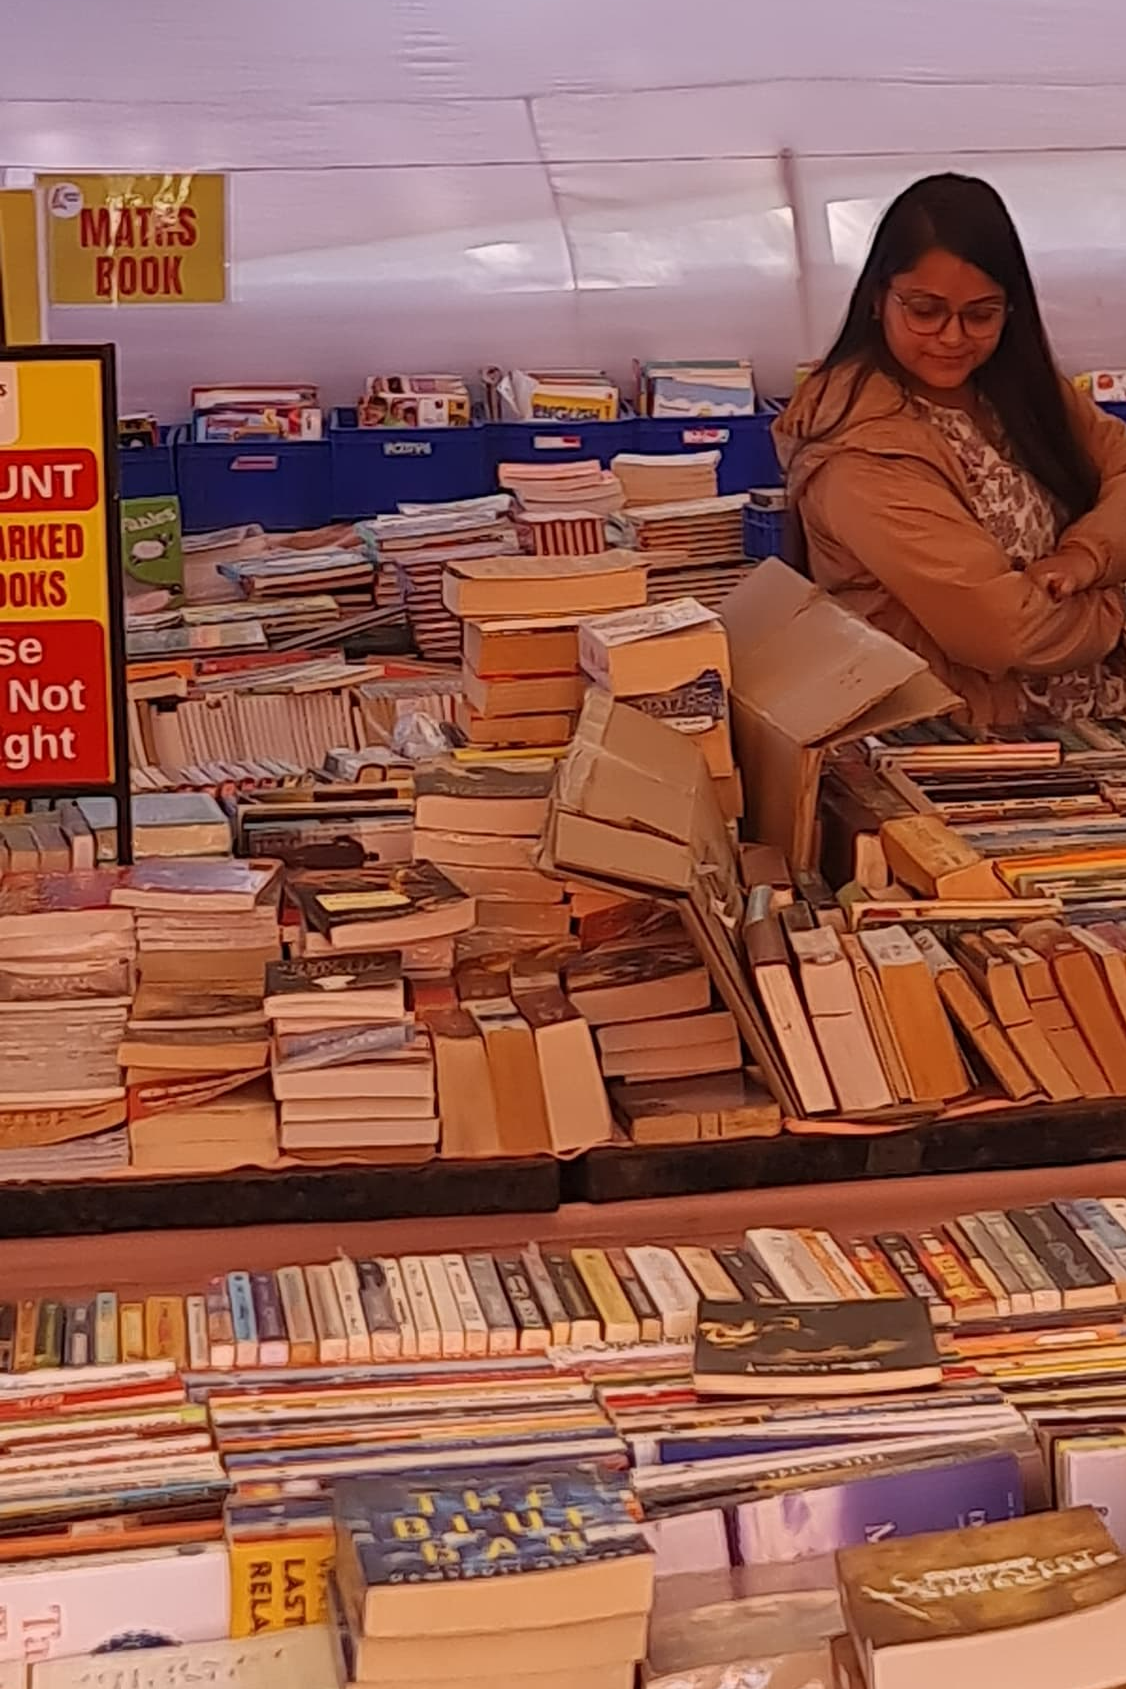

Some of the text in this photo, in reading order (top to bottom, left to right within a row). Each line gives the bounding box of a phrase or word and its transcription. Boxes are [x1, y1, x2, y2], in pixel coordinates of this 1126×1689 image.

[95, 255, 184, 297] BOOK
[0, 523, 85, 562] RKED
[8, 678, 86, 713] Not
[282, 1559, 307, 1626] LAST
